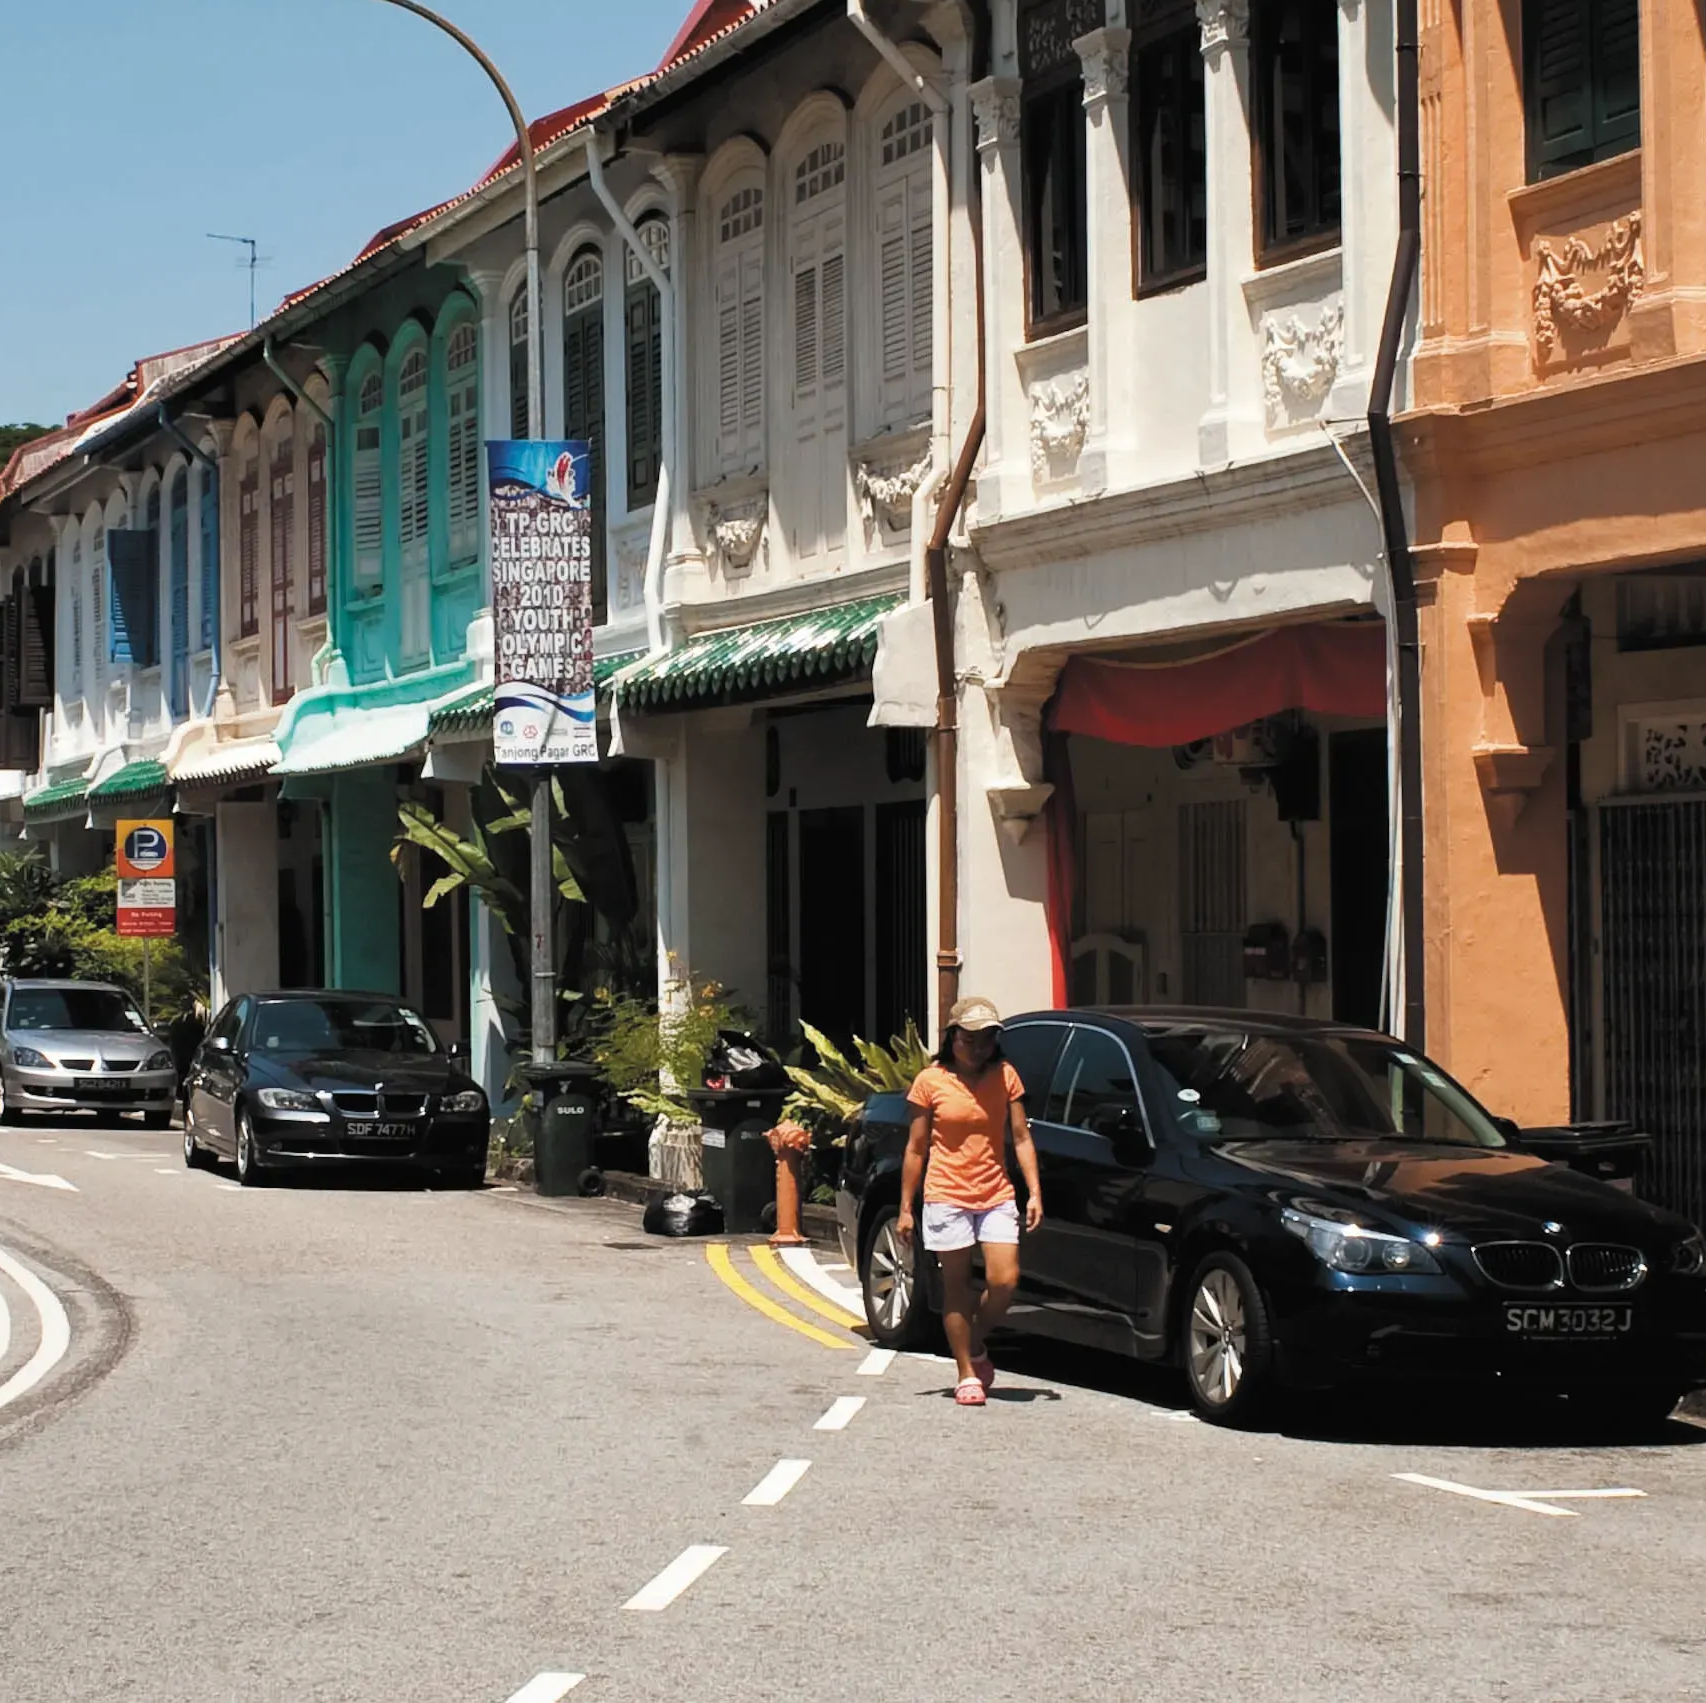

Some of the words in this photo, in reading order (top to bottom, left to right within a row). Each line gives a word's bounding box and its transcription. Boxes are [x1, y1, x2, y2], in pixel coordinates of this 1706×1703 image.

[506, 512, 530, 534] TP
[536, 511, 574, 534] GRC
[492, 535, 591, 558] CELEBRATES
[492, 560, 591, 583] SINGAPORE
[520, 585, 564, 607] 2010
[511, 608, 573, 631] YOUTH
[501, 631, 583, 655] OLYMPIC
[511, 656, 574, 680] GAMES
[495, 745, 538, 762] Tanjong
[540, 744, 569, 761] Pagar
[573, 744, 595, 757] GRC
[556, 1106, 585, 1115] SULO
[1506, 1308, 1633, 1332] SCM3032J
